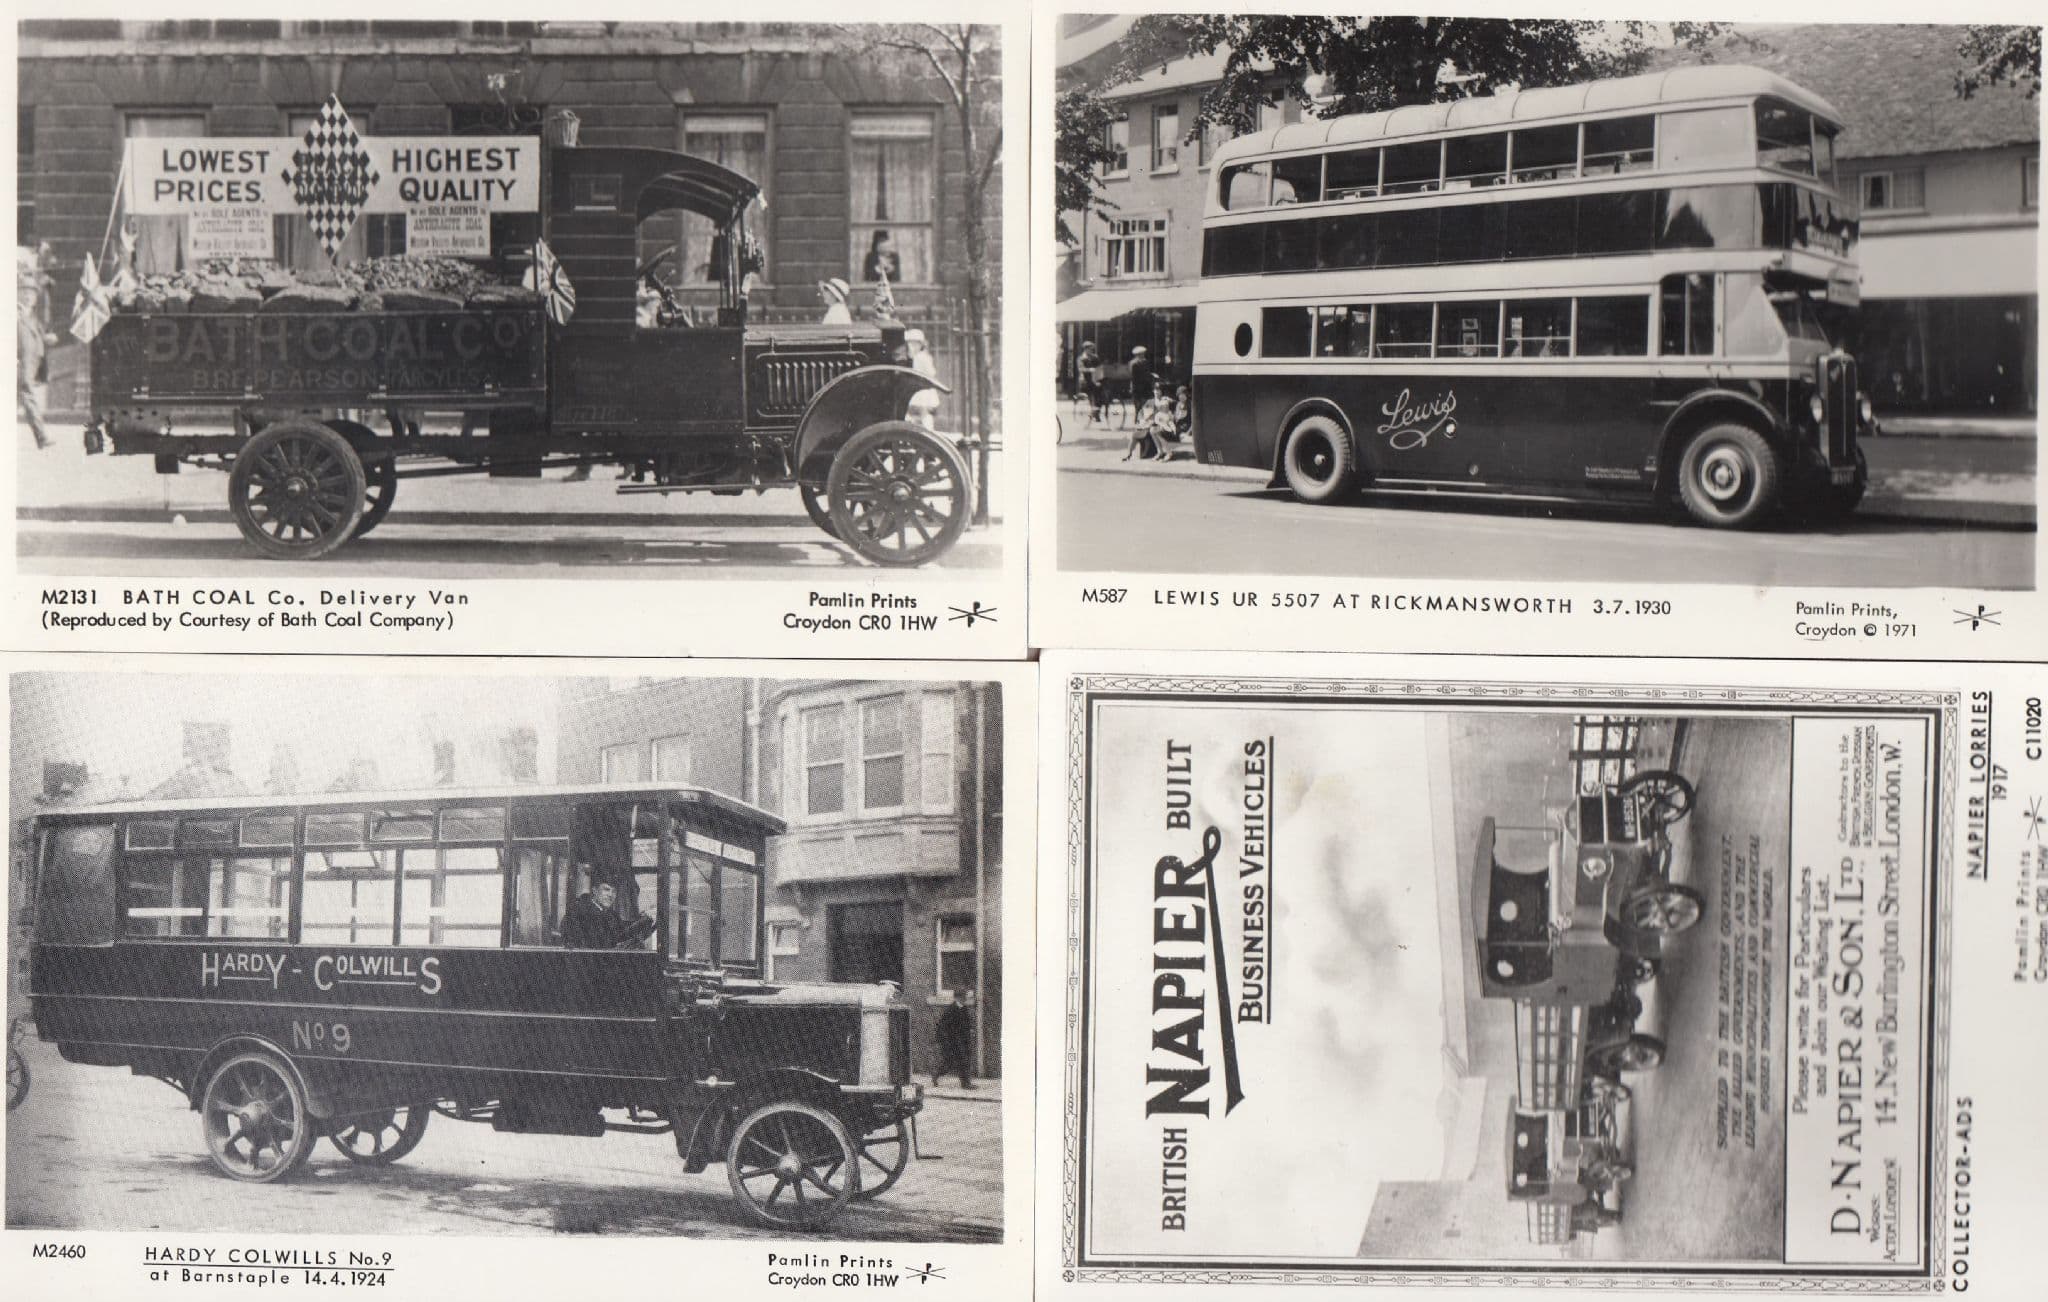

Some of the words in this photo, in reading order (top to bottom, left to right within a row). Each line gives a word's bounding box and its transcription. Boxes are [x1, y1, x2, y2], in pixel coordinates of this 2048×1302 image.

[162, 149, 270, 174] LOWEST
[392, 147, 520, 173] HIGHEST
[154, 178, 265, 203] PRICES.
[399, 177, 516, 203] QUALITY
[147, 318, 289, 363] BATH
[304, 317, 443, 362] COAL
[1377, 387, 1457, 449] Lewis
[42, 590, 96, 604] M2131
[124, 590, 179, 604] BATH
[193, 590, 254, 604] COAL
[268, 591, 304, 605] Co.
[321, 590, 416, 609] Delivery
[429, 591, 468, 604] Van
[810, 592, 864, 608] Pamlin
[872, 593, 916, 608] Prints
[1083, 589, 1127, 603] M587
[1155, 590, 1218, 606] LEWIS
[1233, 592, 1257, 606] UR
[1272, 593, 1319, 607] 5507
[1333, 594, 1359, 608] AT
[1372, 595, 1571, 613] RICKMANSWORTH
[1797, 602, 1844, 615] Pamlin
[1852, 603, 1897, 619] Prints,
[42, 611, 146, 630] (Reproduced
[153, 612, 172, 631] by
[180, 612, 250, 631] Courtesy
[258, 612, 275, 626] of
[282, 612, 316, 626] Bath
[325, 611, 361, 627] Coal
[370, 611, 453, 631] Company)
[784, 613, 851, 633] Croydon
[901, 616, 937, 630] 1HW
[1795, 622, 1856, 638] Croydon
[1885, 624, 1917, 637] 1971
[1839, 735, 1849, 753] the
[1970, 691, 1987, 783] LORRIES
[2026, 698, 2042, 760] C11020
[1839, 757, 1849, 771] to
[1166, 739, 1191, 830] BUILT
[1991, 764, 2008, 800] 1917
[1239, 740, 1266, 878] VEHICLES
[1967, 796, 1984, 879] NAPIER
[1735, 854, 1746, 885] THE
[2016, 850, 2030, 907] Prints
[1734, 892, 1745, 925] AND
[1794, 866, 1811, 969] Particulars
[1238, 885, 1264, 1024] BUSINESS
[1812, 918, 1832, 980] Waiting
[2014, 917, 2028, 982] Pamlin
[201, 952, 286, 990] HARDY
[314, 955, 442, 995] COLWILLS
[1145, 826, 1222, 1119] NAPIER
[1795, 974, 1810, 998] for
[1876, 920, 1904, 1034] Burlington
[1816, 983, 1828, 1012] our
[1718, 1009, 1729, 1040] THE
[1795, 1005, 1809, 1048] write
[1840, 1005, 1862, 1029] &
[332, 1023, 350, 1052] 9
[1875, 1037, 1897, 1088] New
[1792, 1056, 1809, 1114] Please
[1813, 1064, 1827, 1096] and
[1162, 1127, 1187, 1232] BRITISH
[1952, 1097, 1972, 1292] COLLECTOR-ADS
[32, 1244, 86, 1259] M2460
[145, 1247, 217, 1262] HARDY
[228, 1249, 337, 1265] COLWILLS
[769, 1254, 829, 1267] Pamlin
[840, 1255, 892, 1268] Prints
[149, 1269, 169, 1281] at
[181, 1269, 290, 1287] Barnstaple
[304, 1271, 386, 1287] 14.4.1924
[769, 1272, 826, 1288] Croydon
[867, 1273, 899, 1287] 1HW
